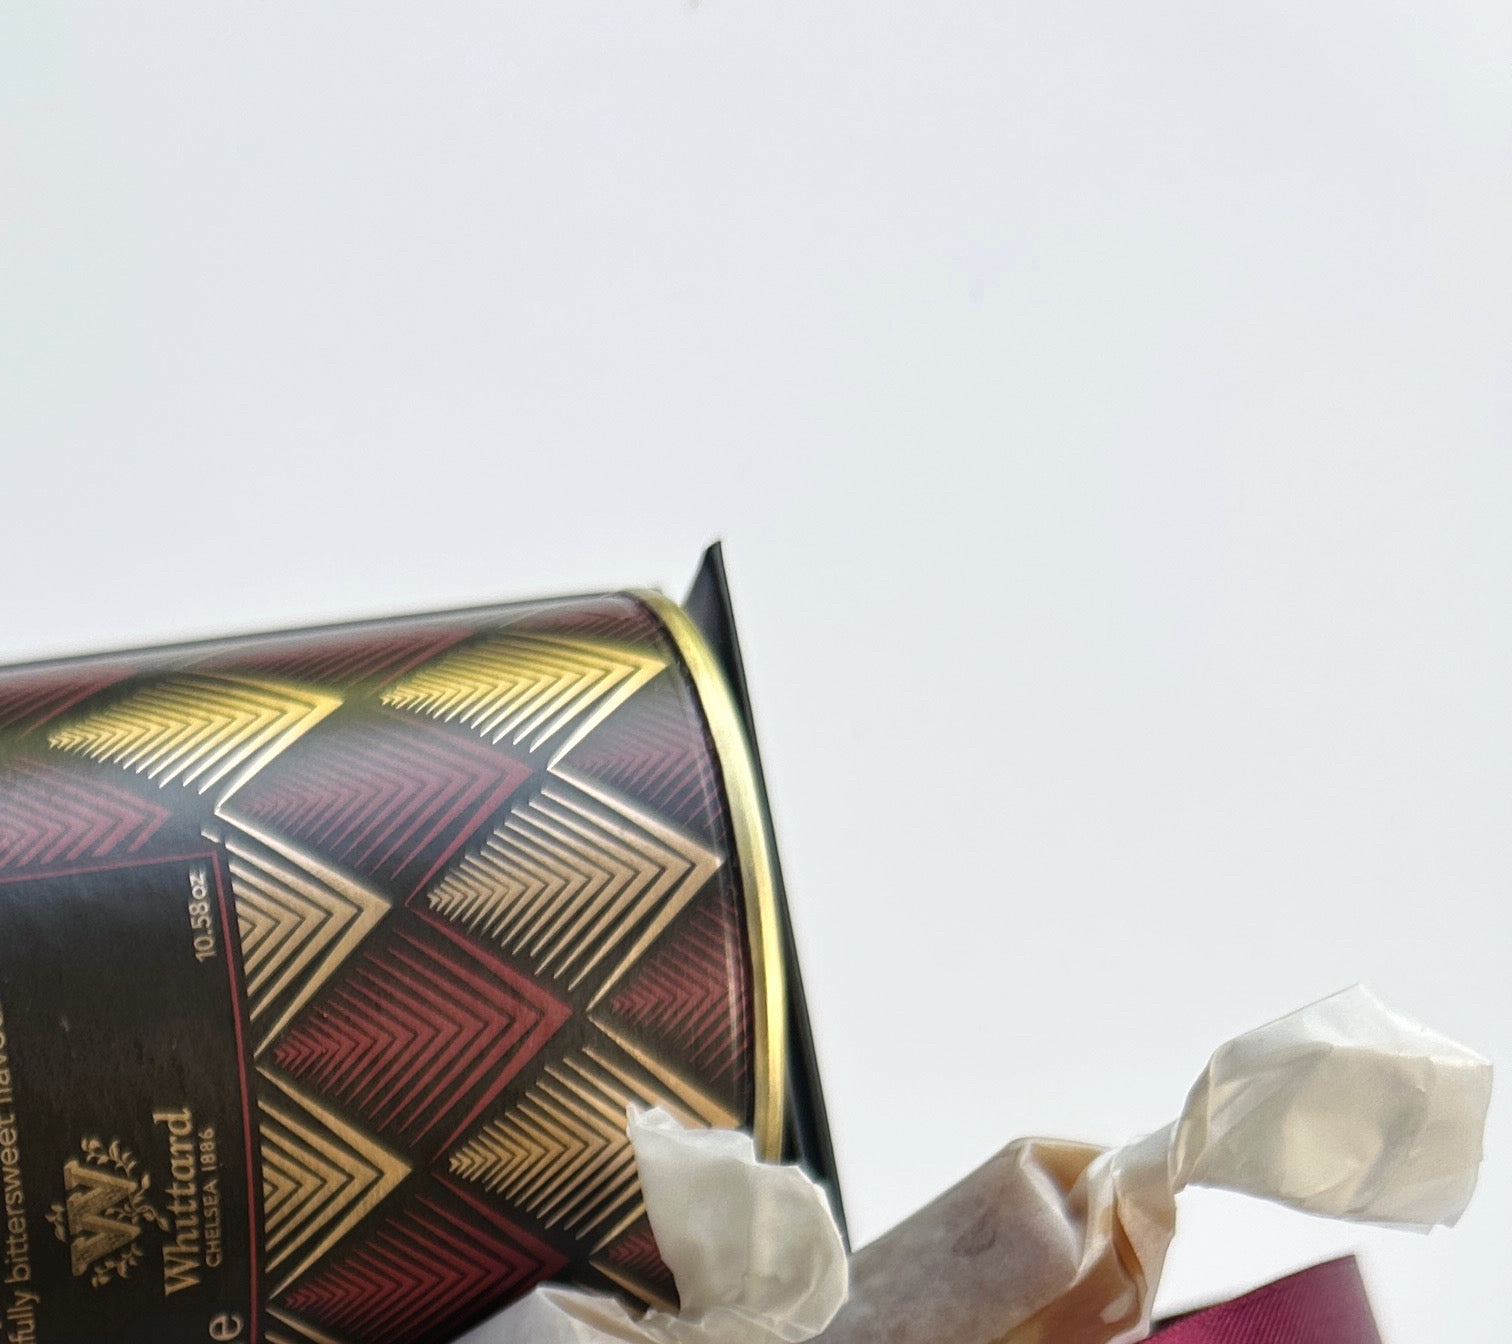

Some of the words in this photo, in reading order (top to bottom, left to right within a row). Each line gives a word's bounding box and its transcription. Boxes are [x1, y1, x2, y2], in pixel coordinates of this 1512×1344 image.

[199, 1127, 216, 1171] 1886
[153, 1107, 200, 1296] Whittard
[202, 1178, 222, 1268] CHELSEA
